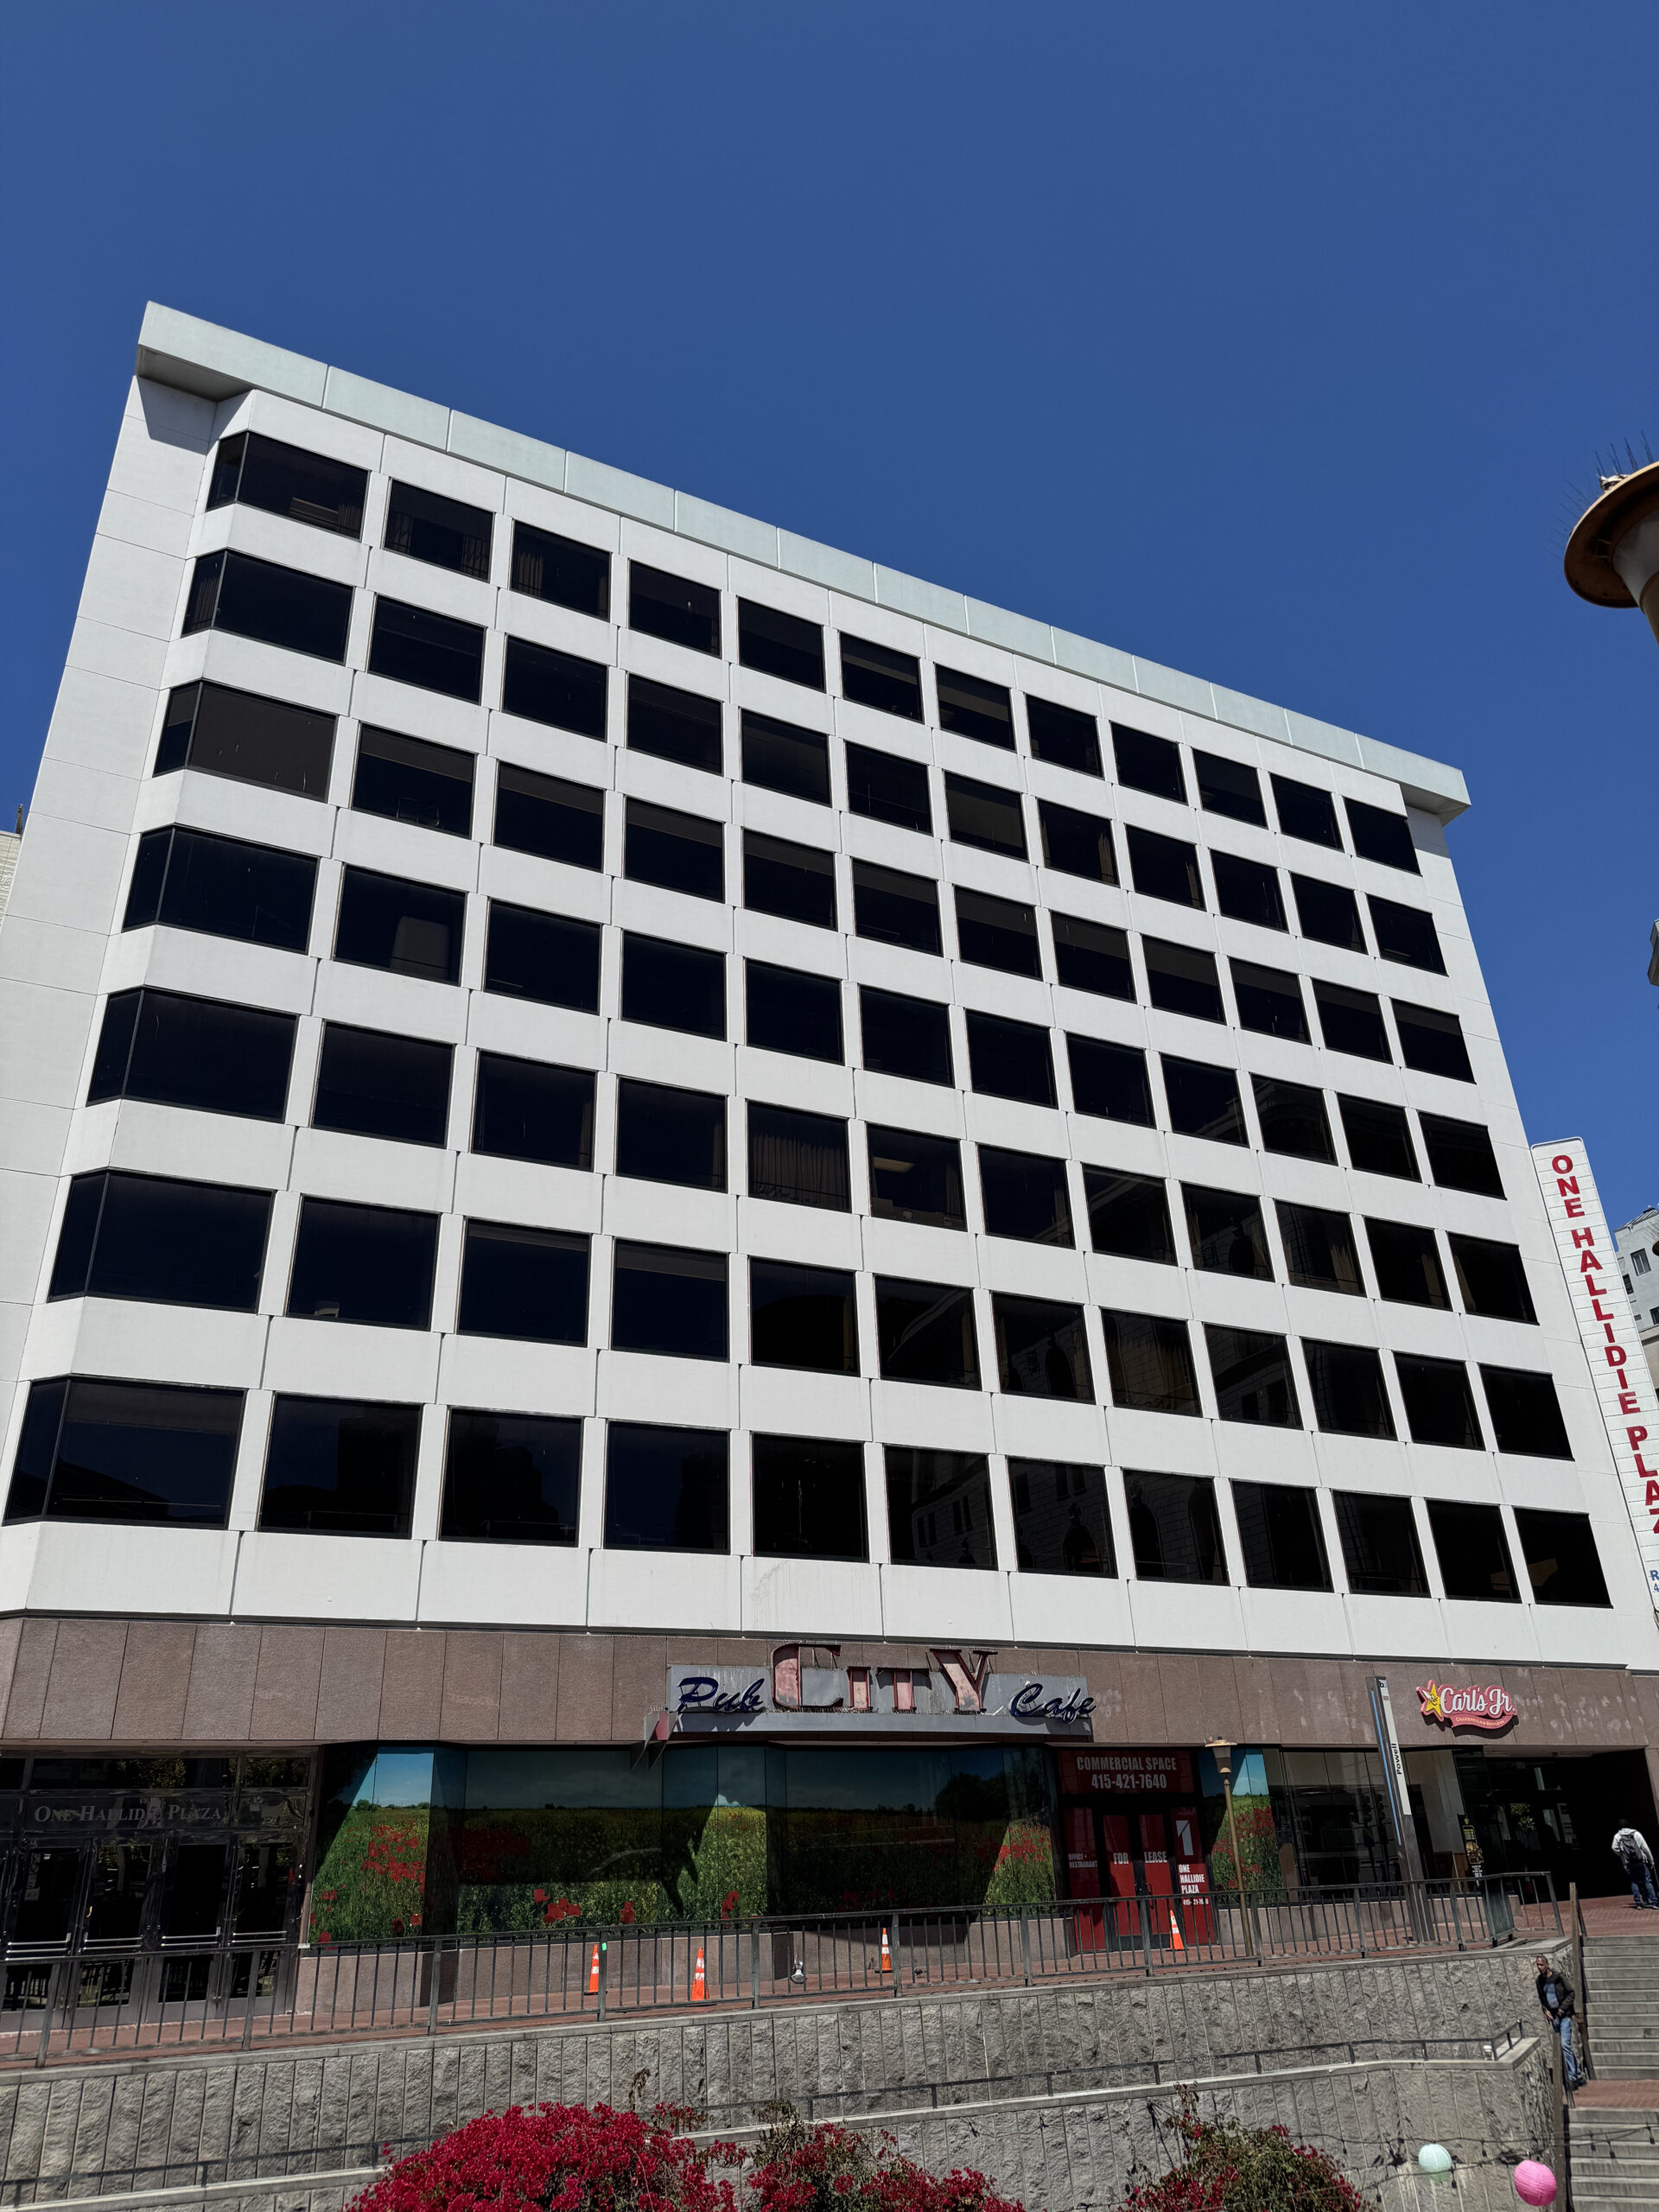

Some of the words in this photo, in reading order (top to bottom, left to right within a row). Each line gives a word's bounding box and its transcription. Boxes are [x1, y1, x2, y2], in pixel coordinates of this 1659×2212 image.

[1551, 1154, 1585, 1218] ONE
[1571, 1227, 1641, 1414] HALLIDIE
[677, 1675, 765, 1713] Pub
[1010, 1681, 1097, 1725] Cafe
[1440, 1688, 1488, 1714] Carl's
[1077, 1757, 1144, 1770] COMMERCIAL
[1145, 1757, 1177, 1770] SPACE
[1391, 1743, 1402, 1775] Powell
[1091, 1774, 1167, 1789] 415-421-7640
[168, 1804, 221, 1821] PLAZA
[1113, 1852, 1129, 1865] FOR
[1143, 1851, 1167, 1864] LEASE
[1179, 1864, 1190, 1873] ONE
[1179, 1873, 1205, 1884] HALLIDIE
[1181, 1885, 1199, 1894] PLAZA
